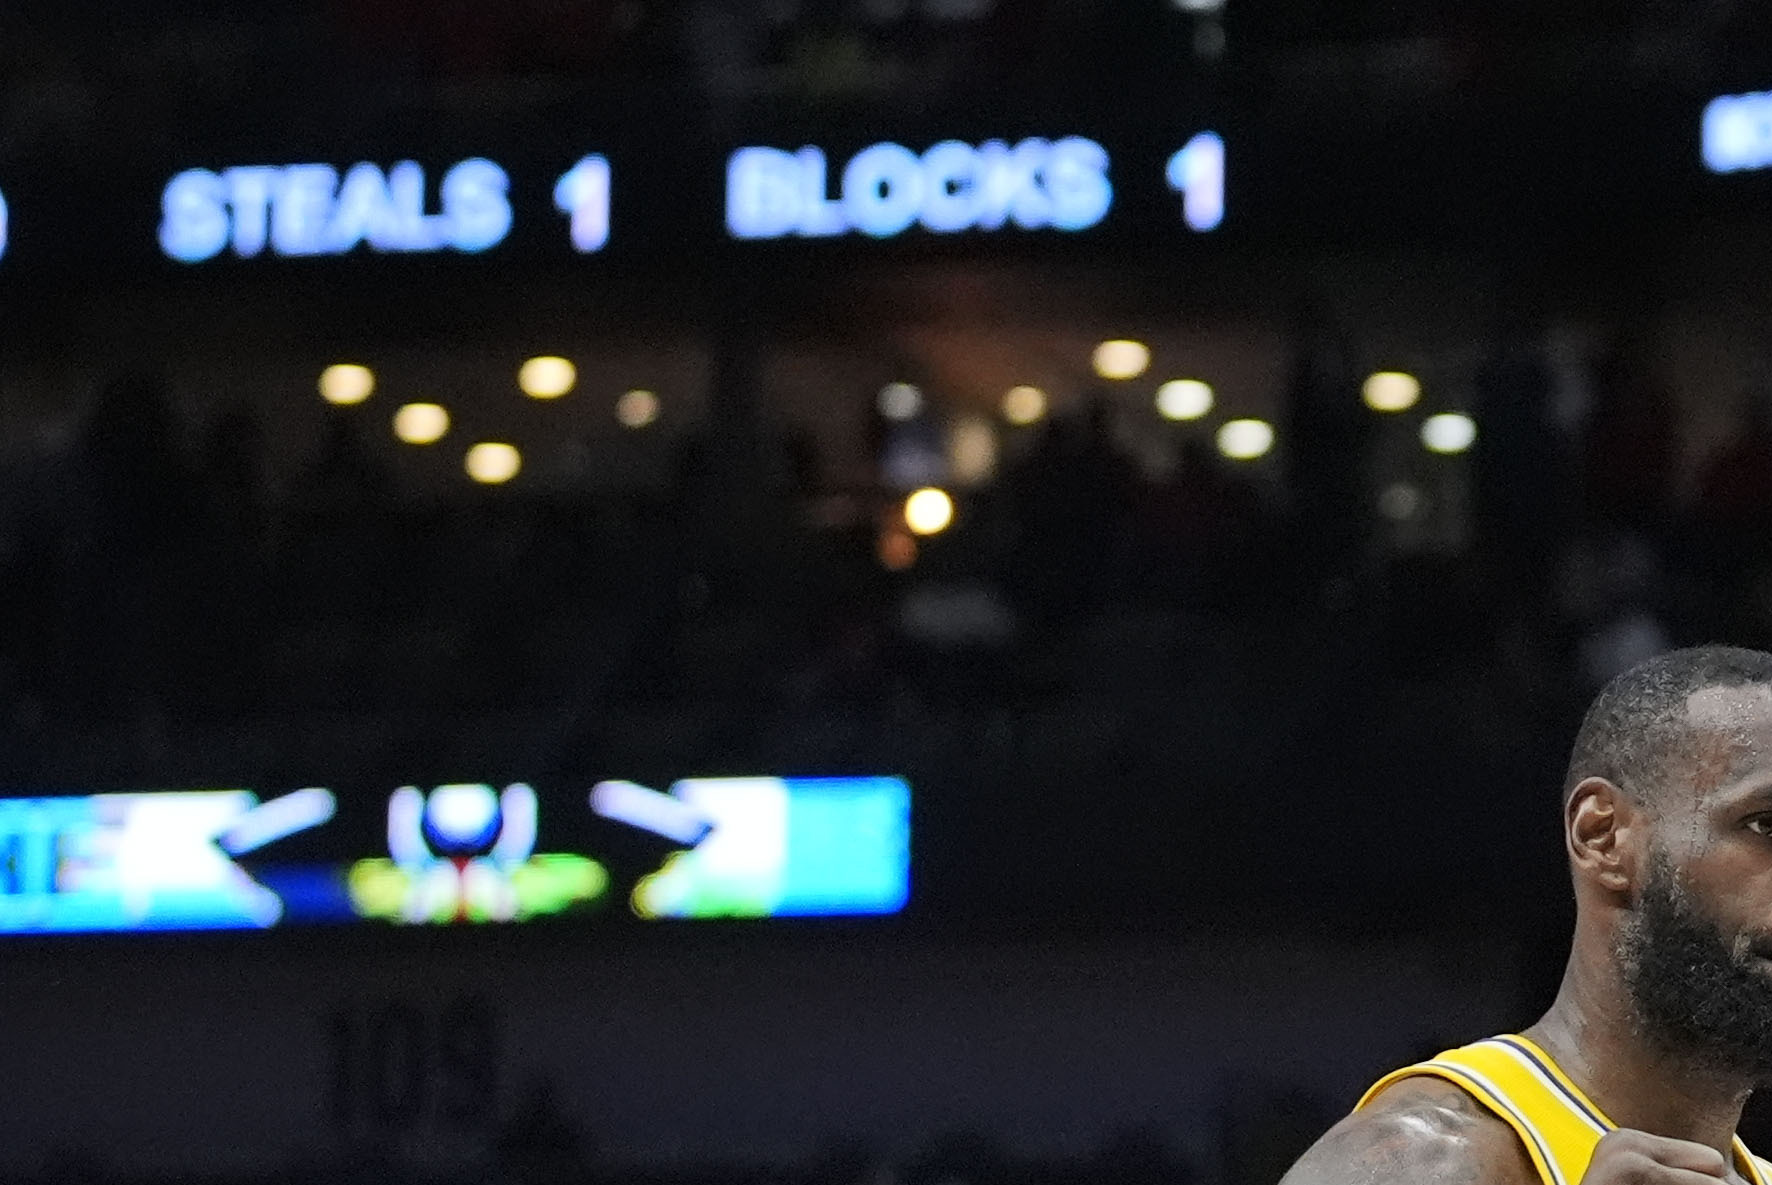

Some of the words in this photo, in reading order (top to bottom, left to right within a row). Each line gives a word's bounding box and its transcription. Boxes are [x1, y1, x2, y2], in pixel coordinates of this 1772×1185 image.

[160, 157, 512, 261] STEALS
[554, 153, 610, 252] 1
[726, 135, 1113, 238] BLOCKS
[1165, 130, 1225, 232] 1
